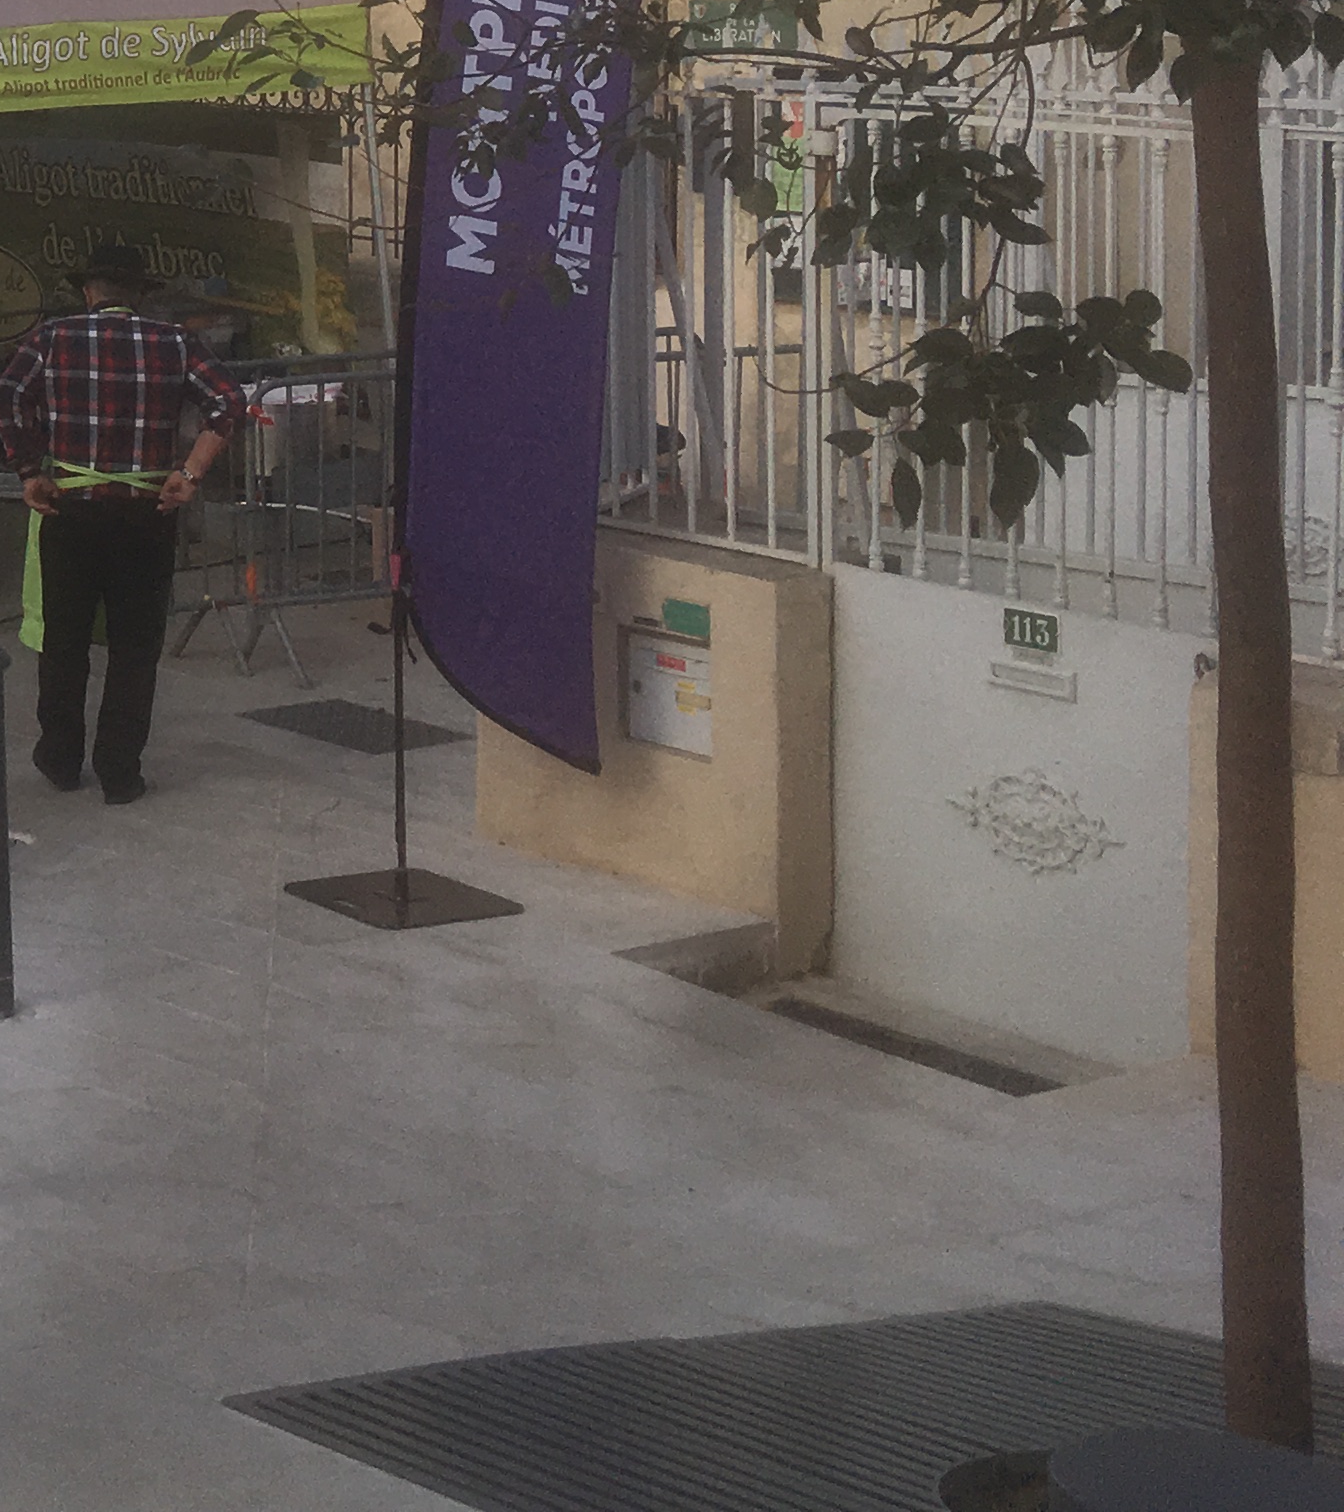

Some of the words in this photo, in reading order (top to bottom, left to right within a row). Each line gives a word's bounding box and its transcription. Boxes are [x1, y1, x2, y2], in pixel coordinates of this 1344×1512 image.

[100, 26, 141, 60] de
[1, 79, 51, 98] Aligot
[54, 70, 149, 94] traditionnel
[153, 68, 173, 86] de
[42, 221, 79, 268] de
[1011, 614, 1050, 647] 113
